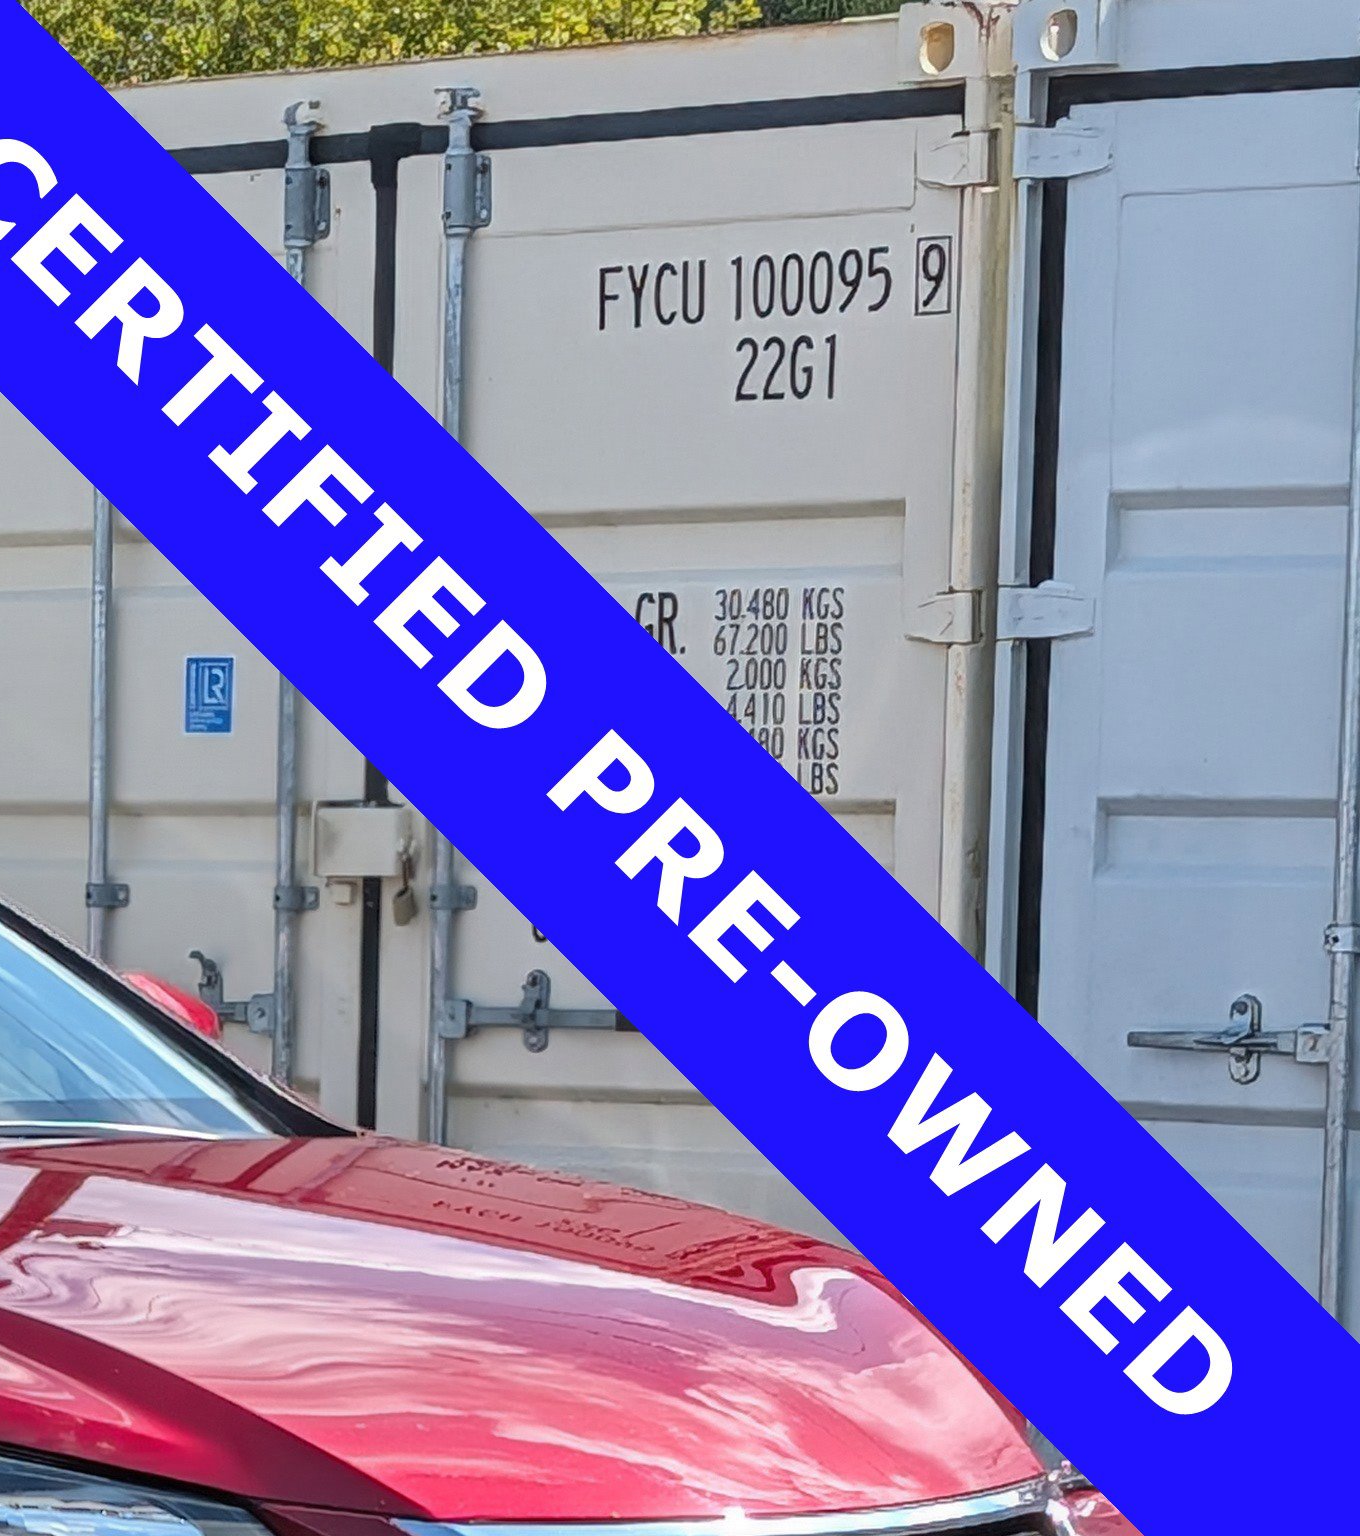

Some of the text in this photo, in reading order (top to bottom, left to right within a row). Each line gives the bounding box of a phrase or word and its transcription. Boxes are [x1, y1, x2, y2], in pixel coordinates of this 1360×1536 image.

[597, 242, 947, 331] FYCU 100095 9
[734, 333, 838, 402] 22G1
[714, 587, 845, 621] 30.480 KGS
[713, 622, 844, 656] 67.200 LBS
[798, 657, 842, 690] KGS
[798, 692, 842, 725] LBS
[796, 727, 839, 760] KGS
